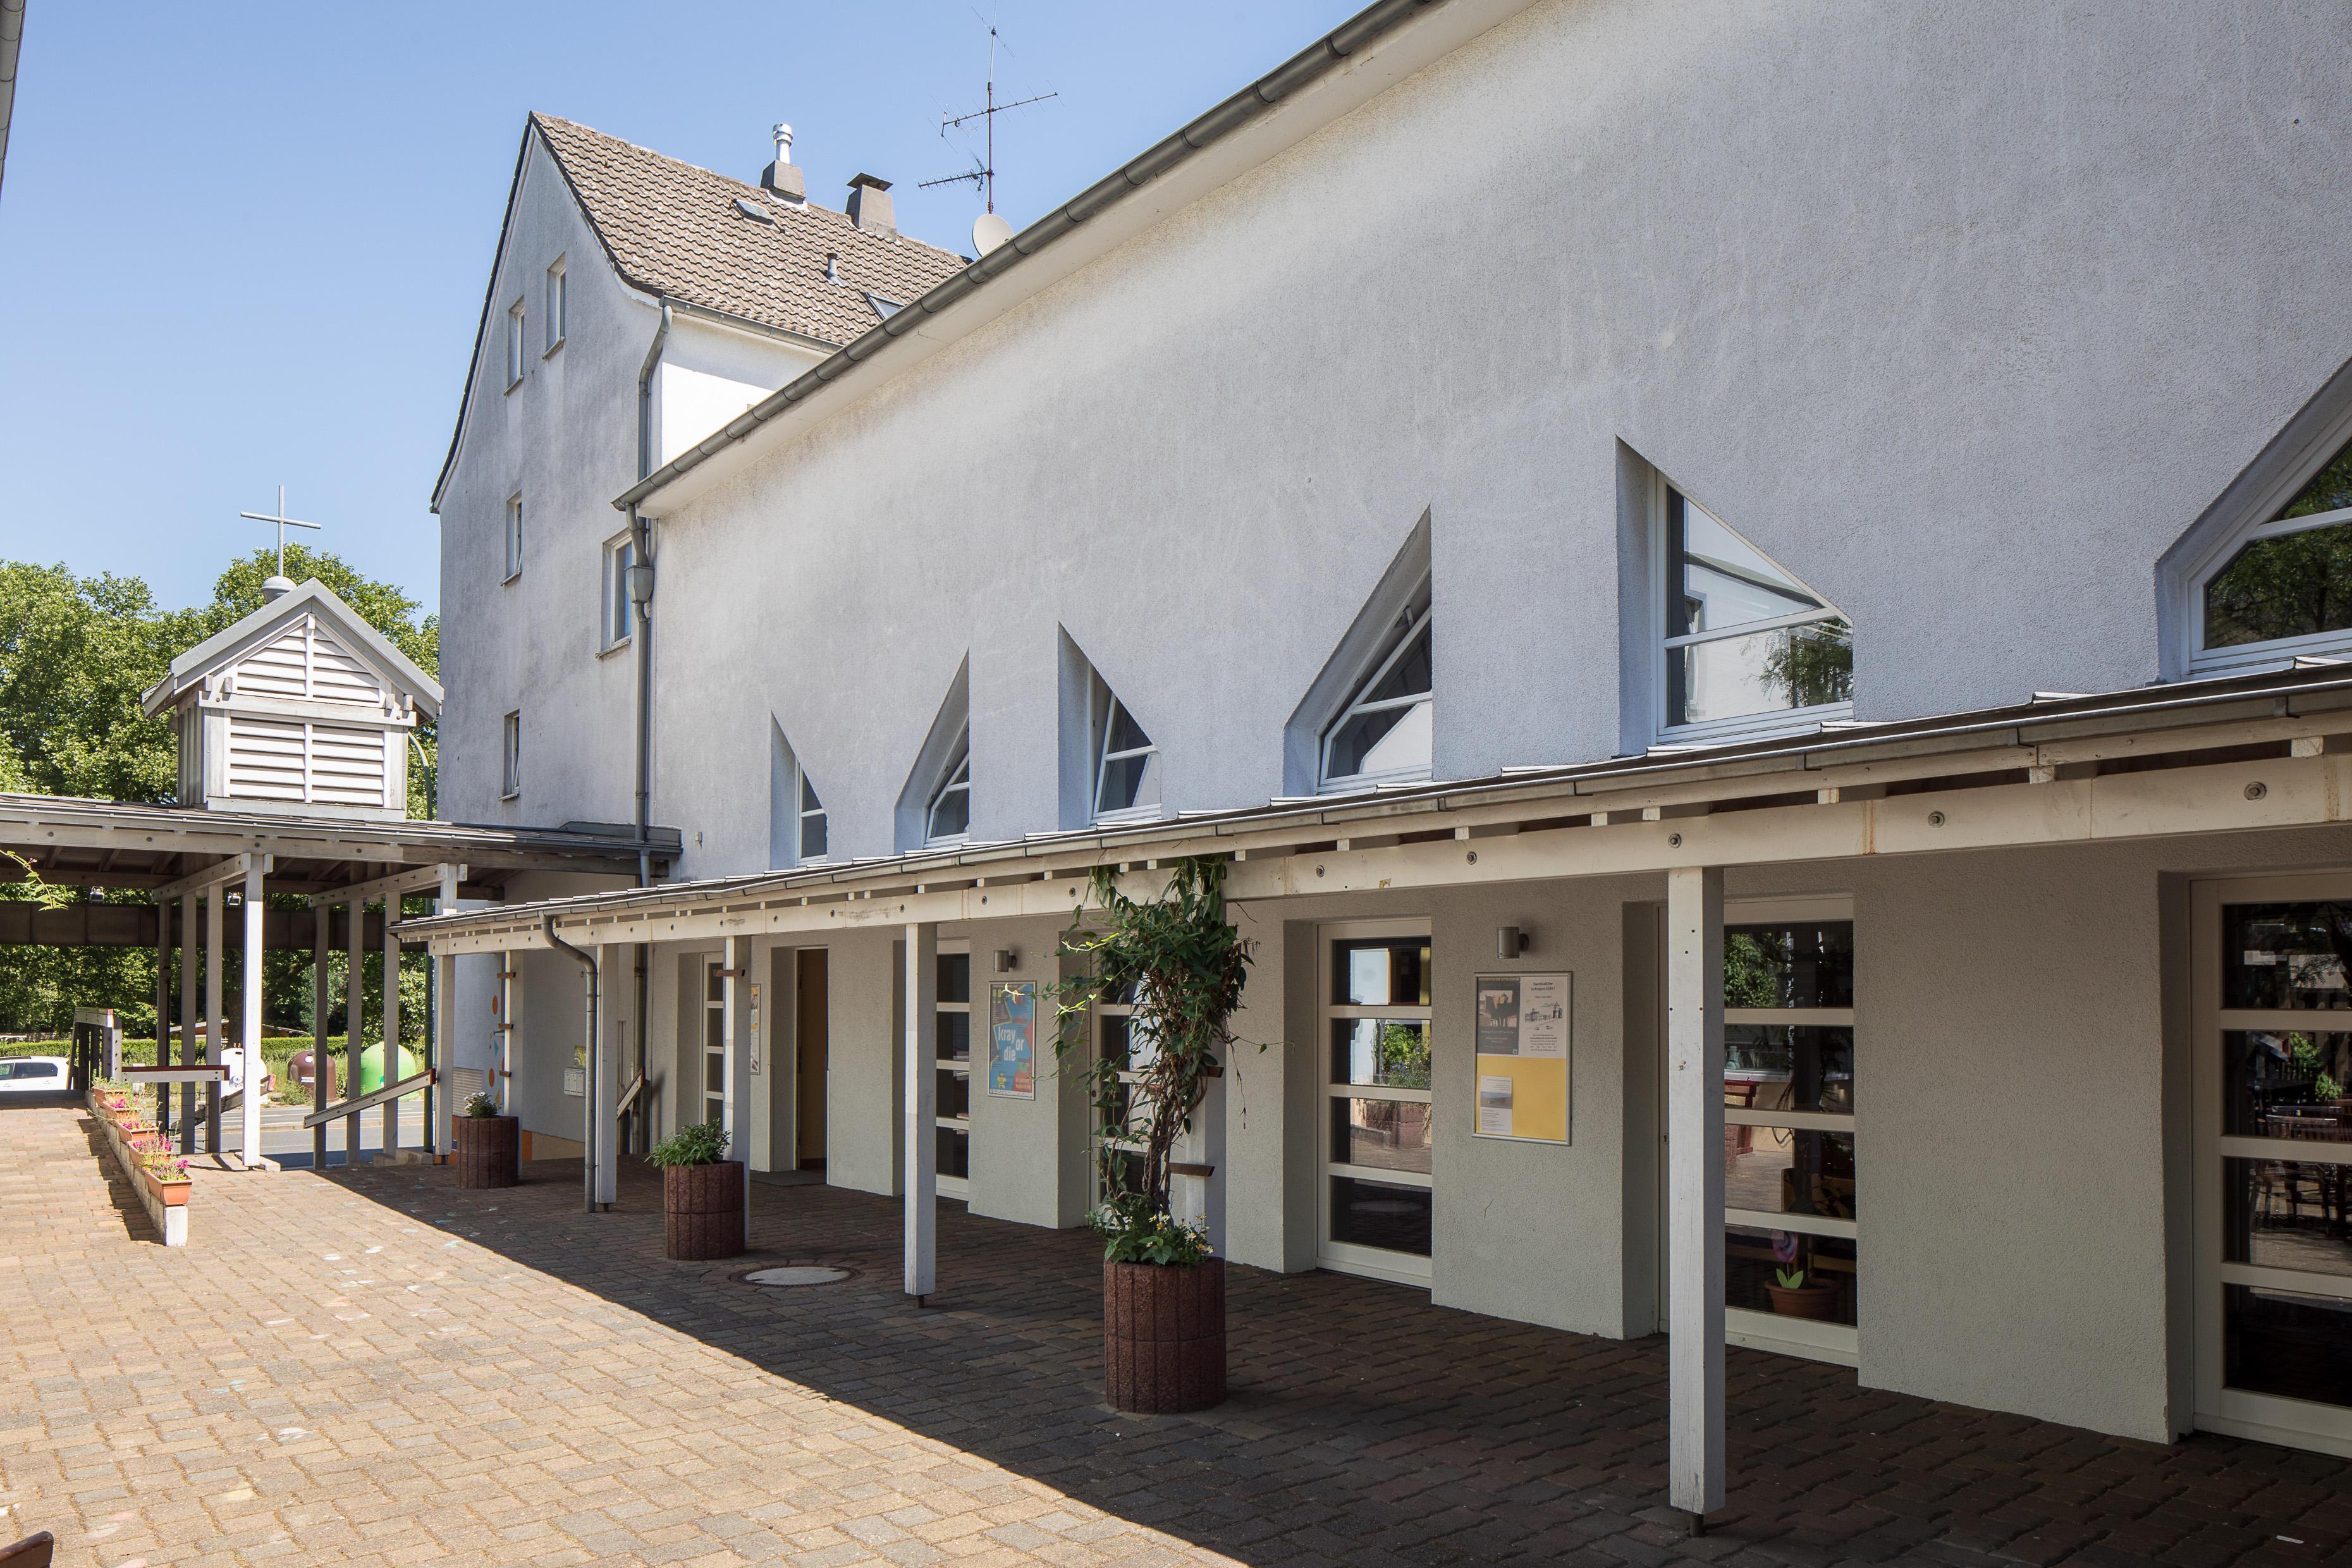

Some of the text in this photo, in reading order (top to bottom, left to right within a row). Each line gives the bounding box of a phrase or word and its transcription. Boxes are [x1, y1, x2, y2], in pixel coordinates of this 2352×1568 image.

[998, 1026, 1016, 1044] kray
[1015, 1039, 1024, 1051] or
[1003, 1046, 1016, 1062] die
